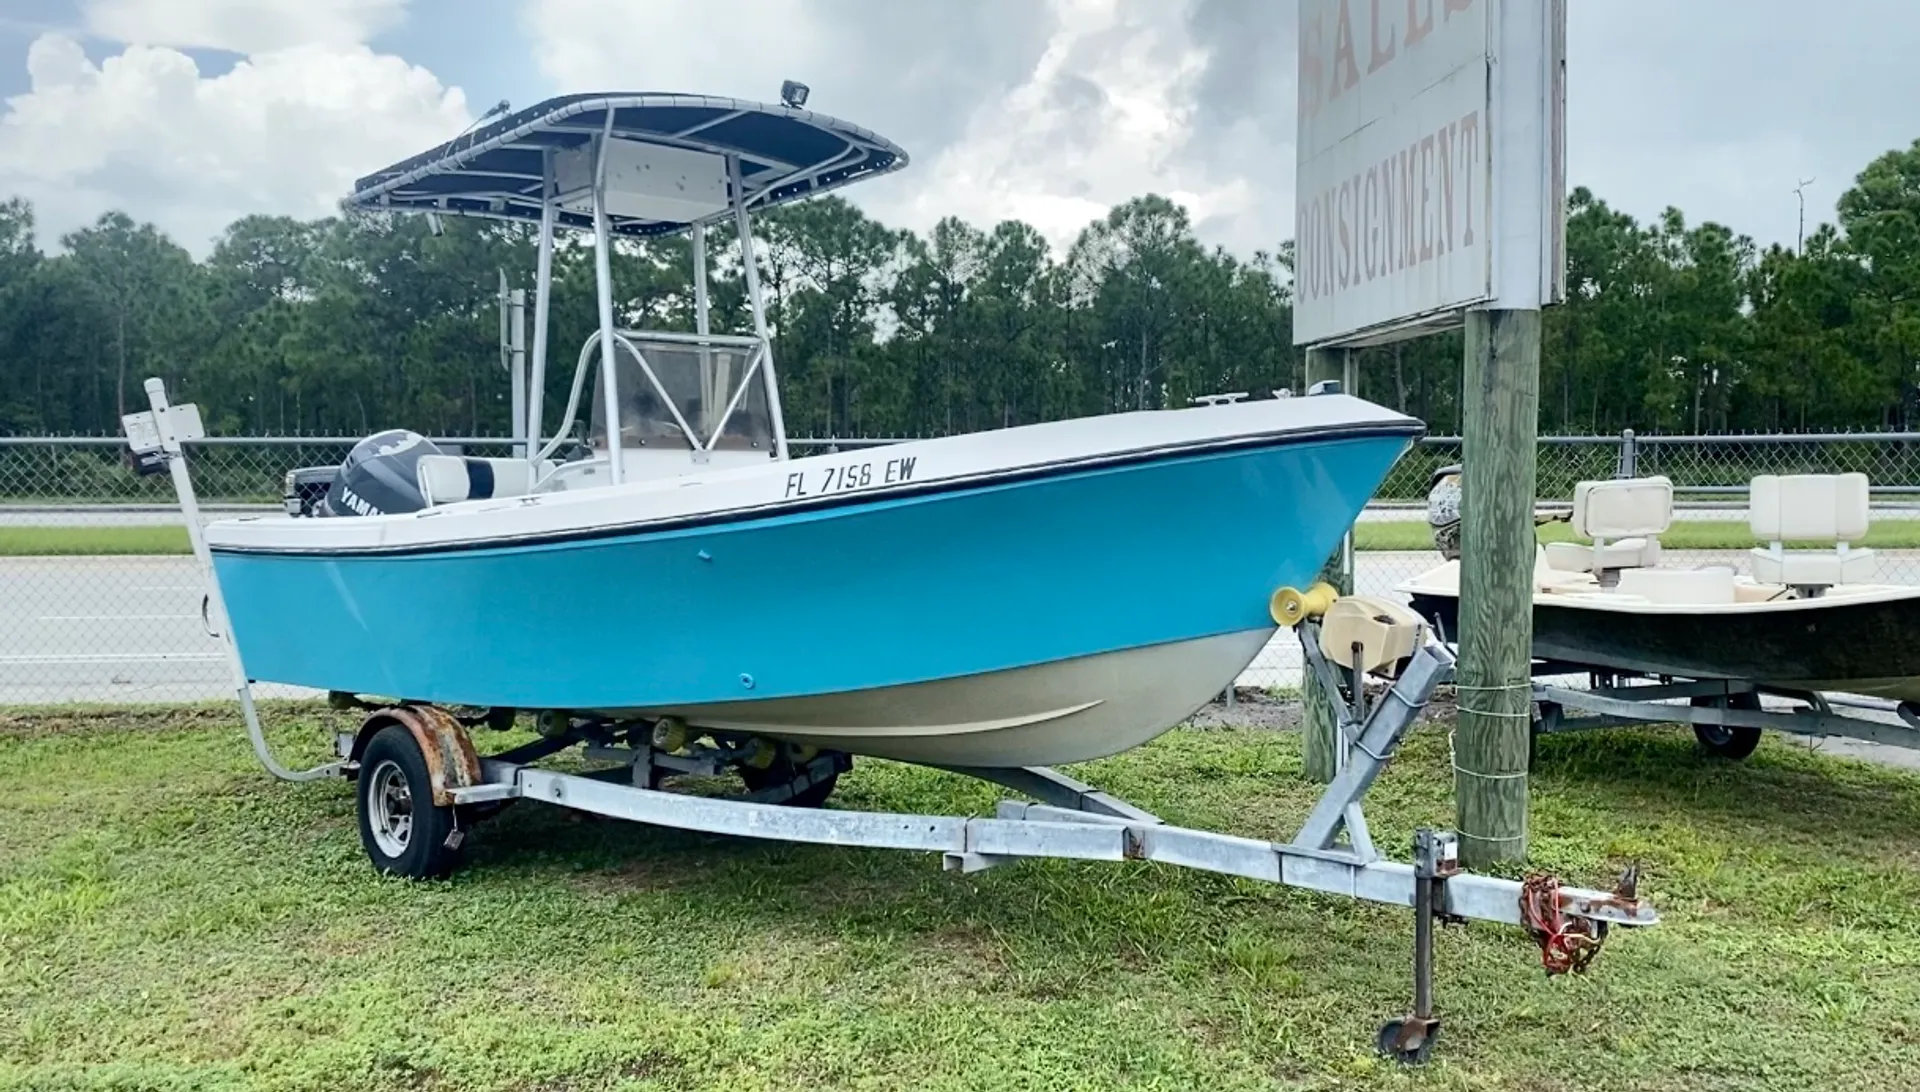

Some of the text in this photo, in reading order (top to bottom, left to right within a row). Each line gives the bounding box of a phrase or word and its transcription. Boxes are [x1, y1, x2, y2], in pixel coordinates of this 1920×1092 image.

[1300, 0, 1474, 118] SAL
[1298, 110, 1478, 304] CONSIGNMENT
[341, 486, 385, 517] YAMA
[785, 456, 917, 498] FL 7158 EW
